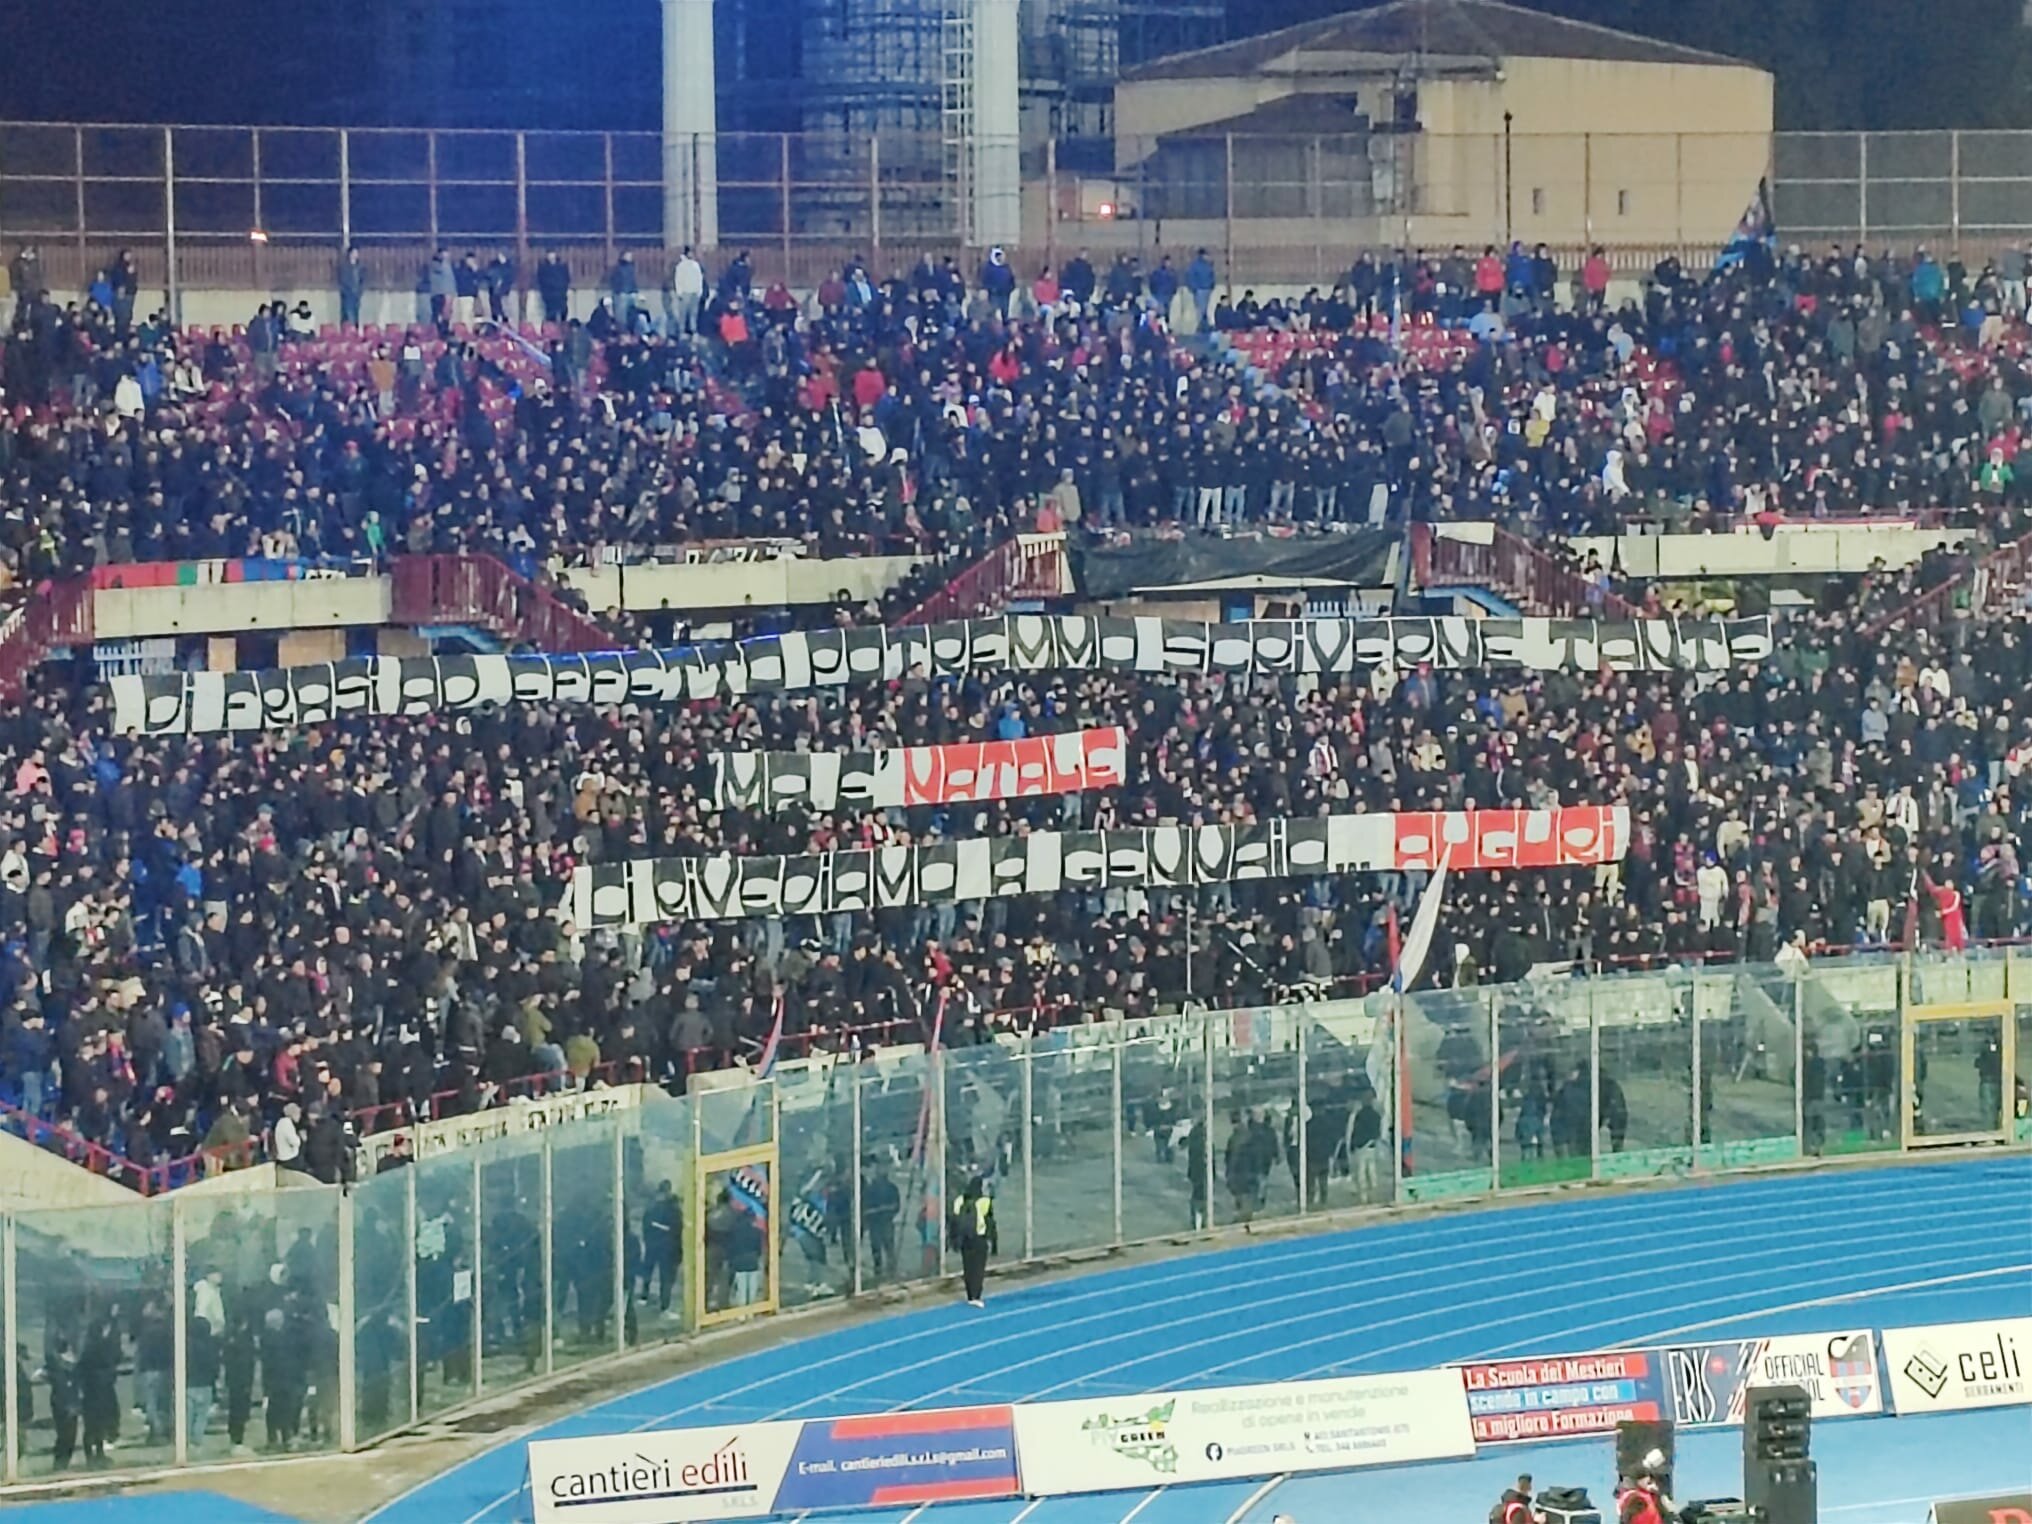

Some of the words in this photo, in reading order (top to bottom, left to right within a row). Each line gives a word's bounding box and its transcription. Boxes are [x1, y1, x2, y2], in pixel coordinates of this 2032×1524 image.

[1466, 1369, 1484, 1390] La
[1488, 1364, 1537, 1387] Scuola
[1540, 1360, 1561, 1383] dei
[1565, 1356, 1626, 1381] Mestieri
[1764, 1353, 1825, 1380] OFFICIAL
[1959, 1333, 2020, 1382] celi
[1191, 1391, 1293, 1414] Realizzazione
[1308, 1384, 1409, 1405] manutenzione
[1524, 1387, 1538, 1407] in
[1543, 1385, 1589, 1407] campo
[1593, 1383, 1618, 1401] con
[1668, 1349, 1716, 1424] ERIS
[1473, 1417, 1487, 1439] la
[1491, 1410, 1549, 1438] migliore
[1552, 1406, 1633, 1432] Formazione
